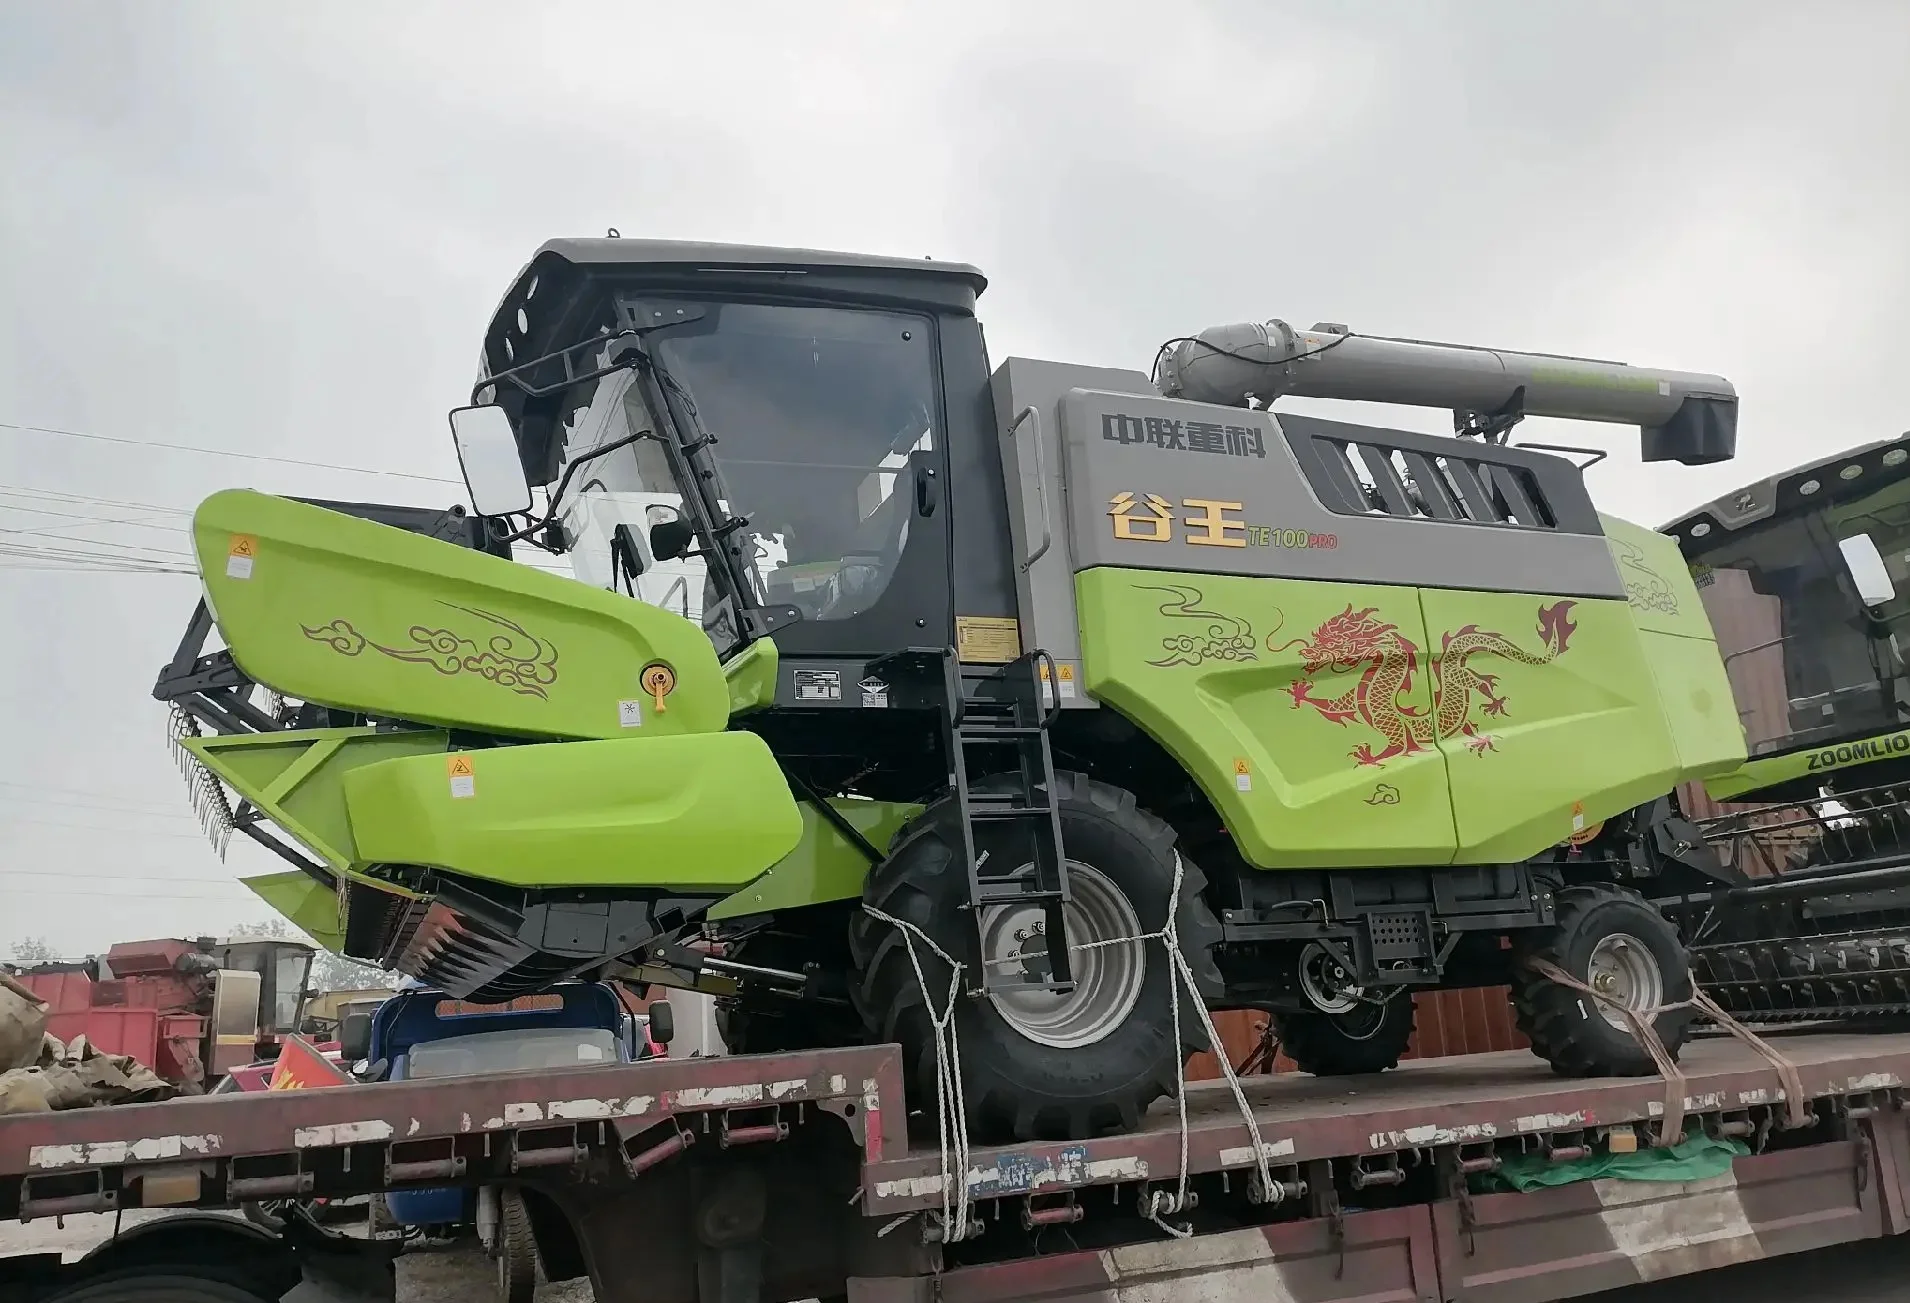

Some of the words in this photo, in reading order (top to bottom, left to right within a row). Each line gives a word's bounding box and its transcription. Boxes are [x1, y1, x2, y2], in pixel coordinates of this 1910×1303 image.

[1101, 413, 1267, 458] 中联重科
[1106, 491, 1247, 548] 谷王
